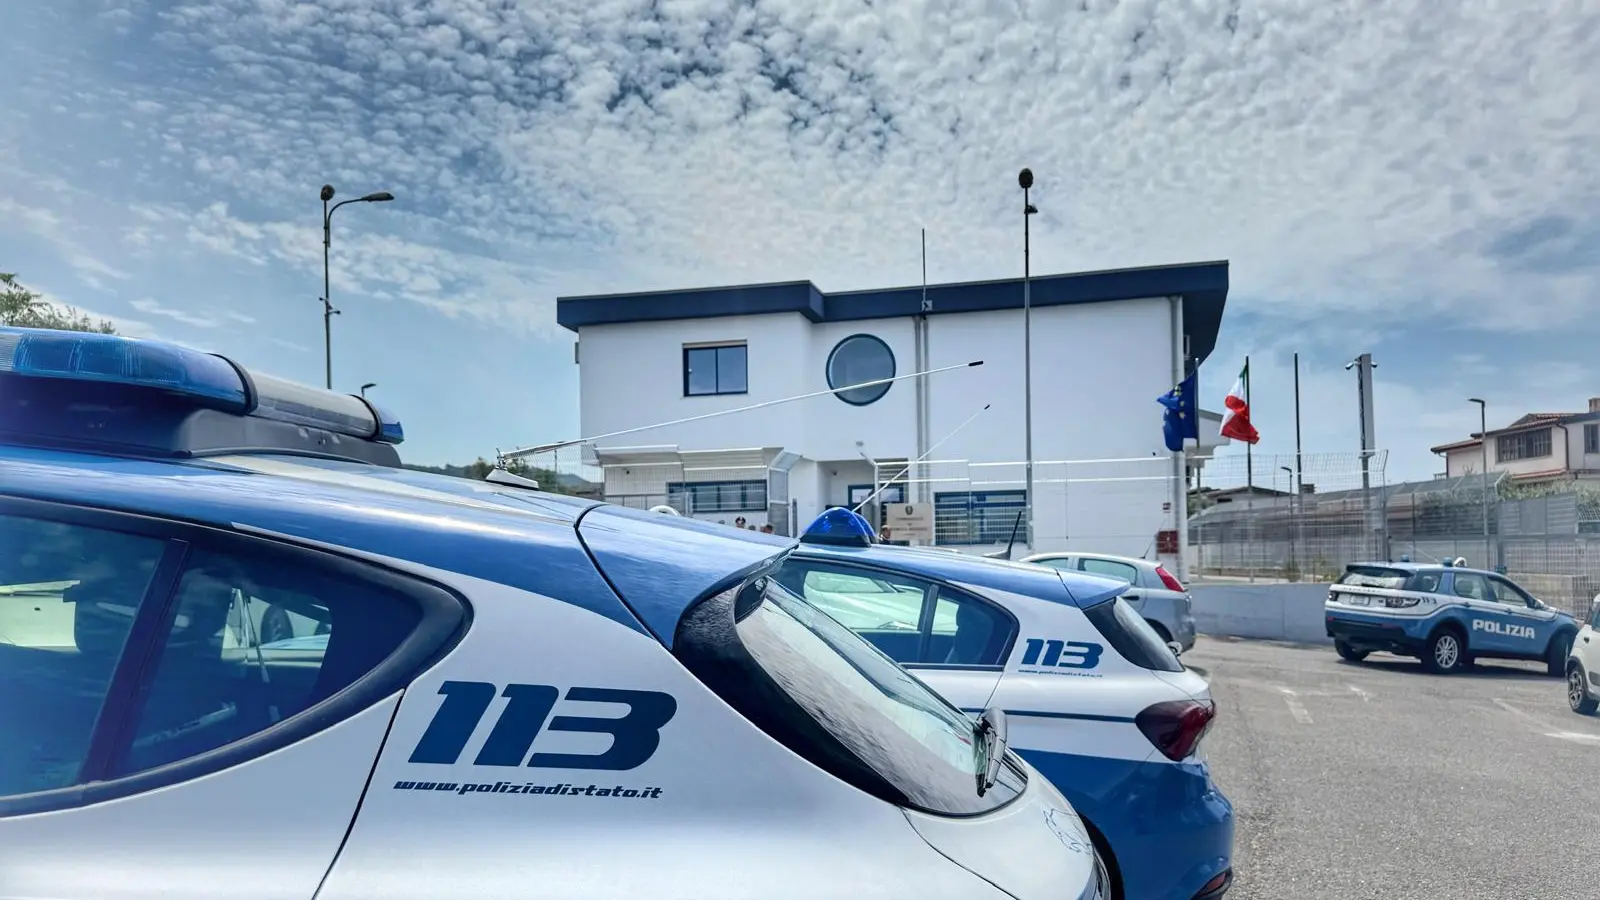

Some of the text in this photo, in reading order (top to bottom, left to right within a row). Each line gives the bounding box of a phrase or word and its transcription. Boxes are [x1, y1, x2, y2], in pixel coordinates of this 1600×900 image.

[1472, 618, 1535, 639] POLIZIA
[1021, 638, 1104, 669] 113
[407, 680, 678, 771] 113
[393, 780, 663, 799] www.poliziadistato.it
